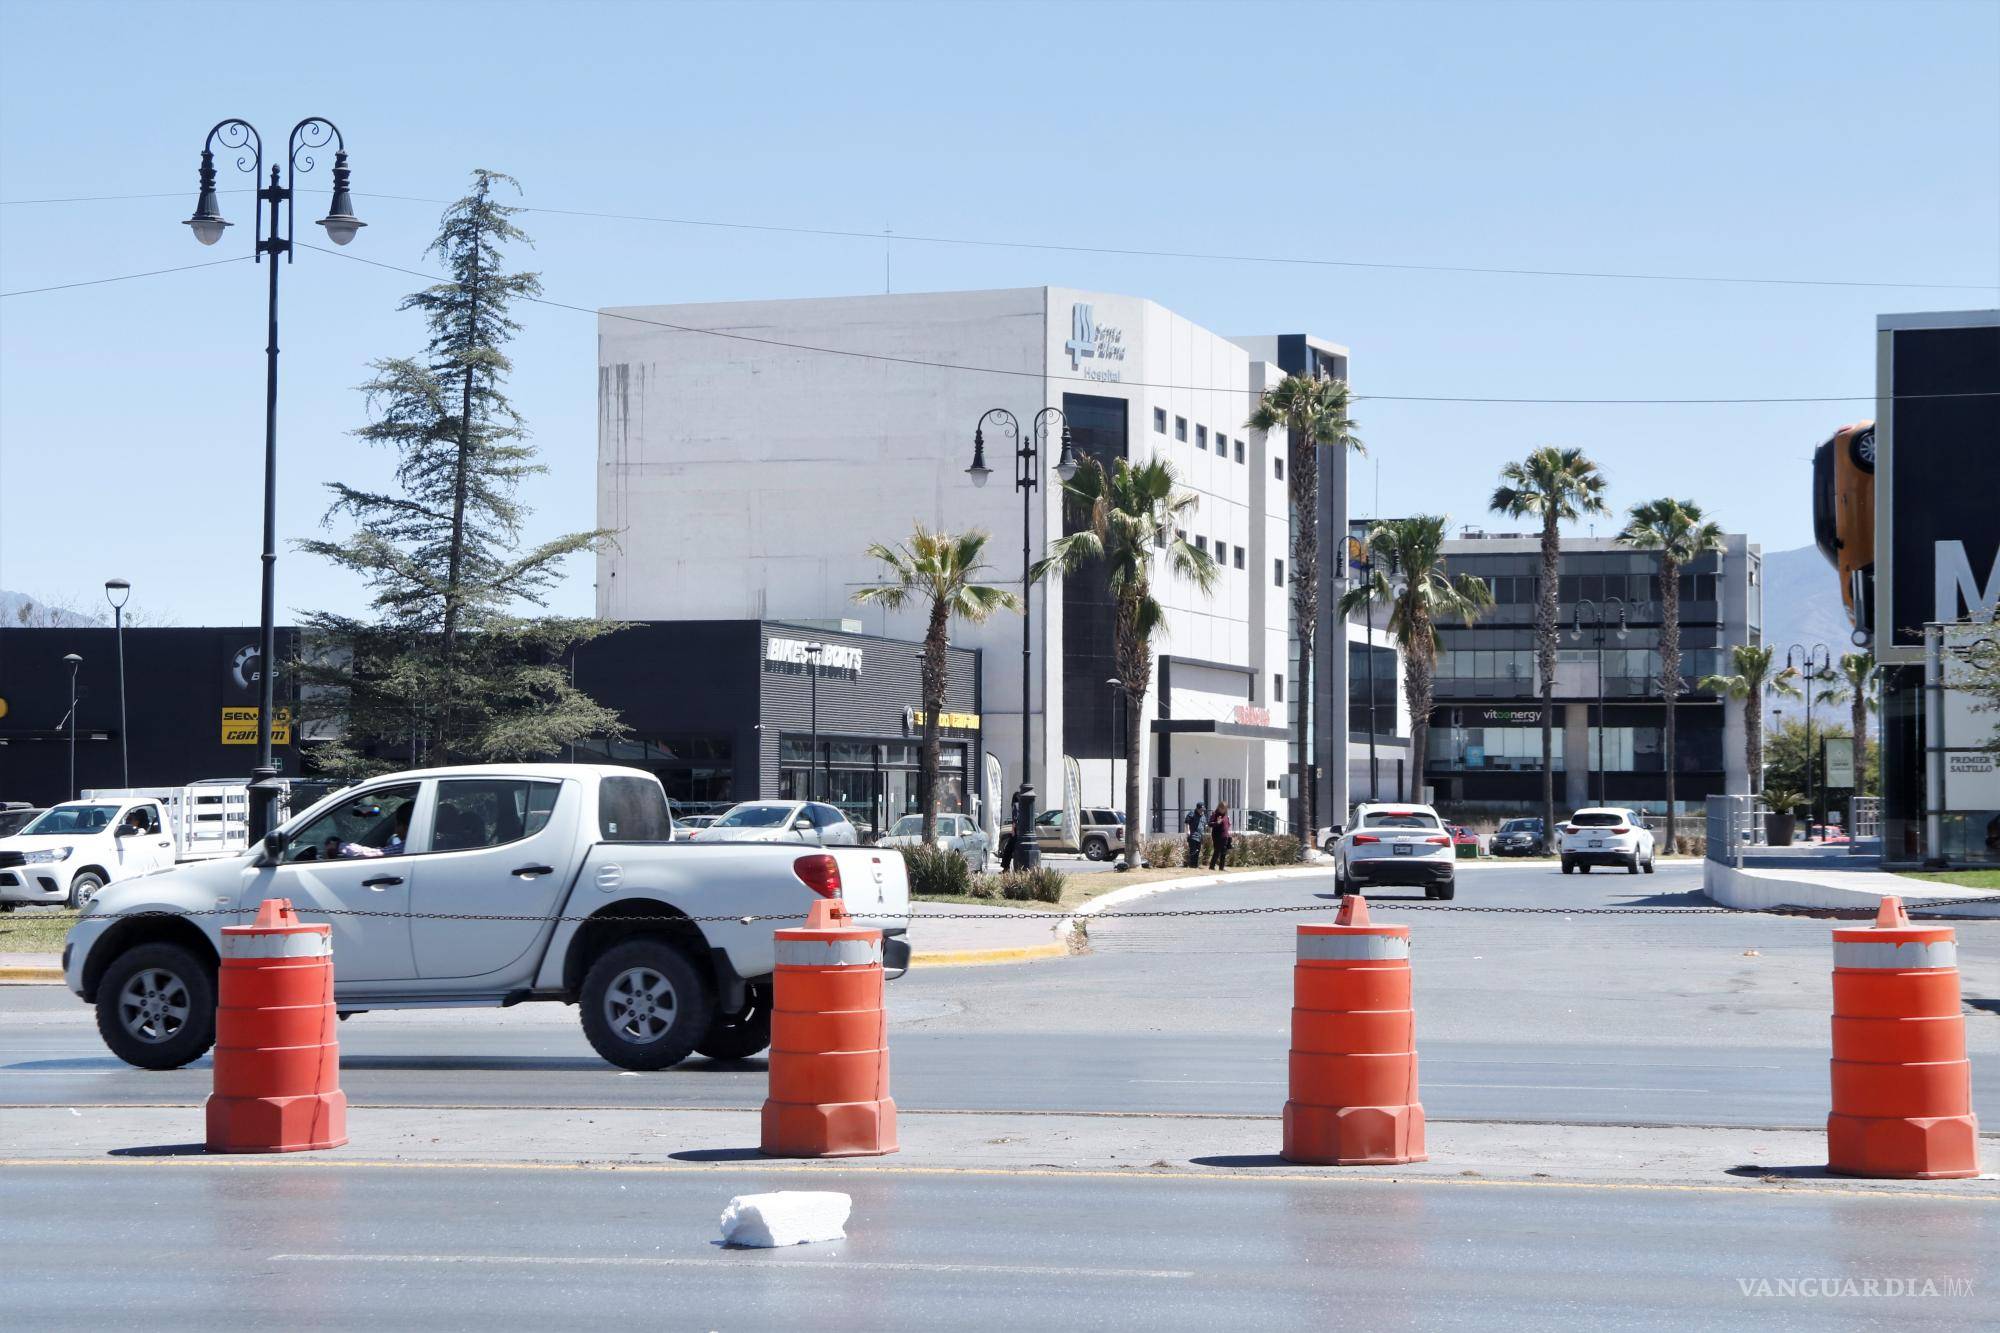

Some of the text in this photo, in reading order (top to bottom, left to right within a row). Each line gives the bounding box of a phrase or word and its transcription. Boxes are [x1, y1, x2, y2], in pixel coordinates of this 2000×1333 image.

[1084, 366, 1120, 382] Hospital
[1935, 540, 2000, 622] M
[767, 638, 808, 663] BIKES
[822, 644, 862, 671] BOATS
